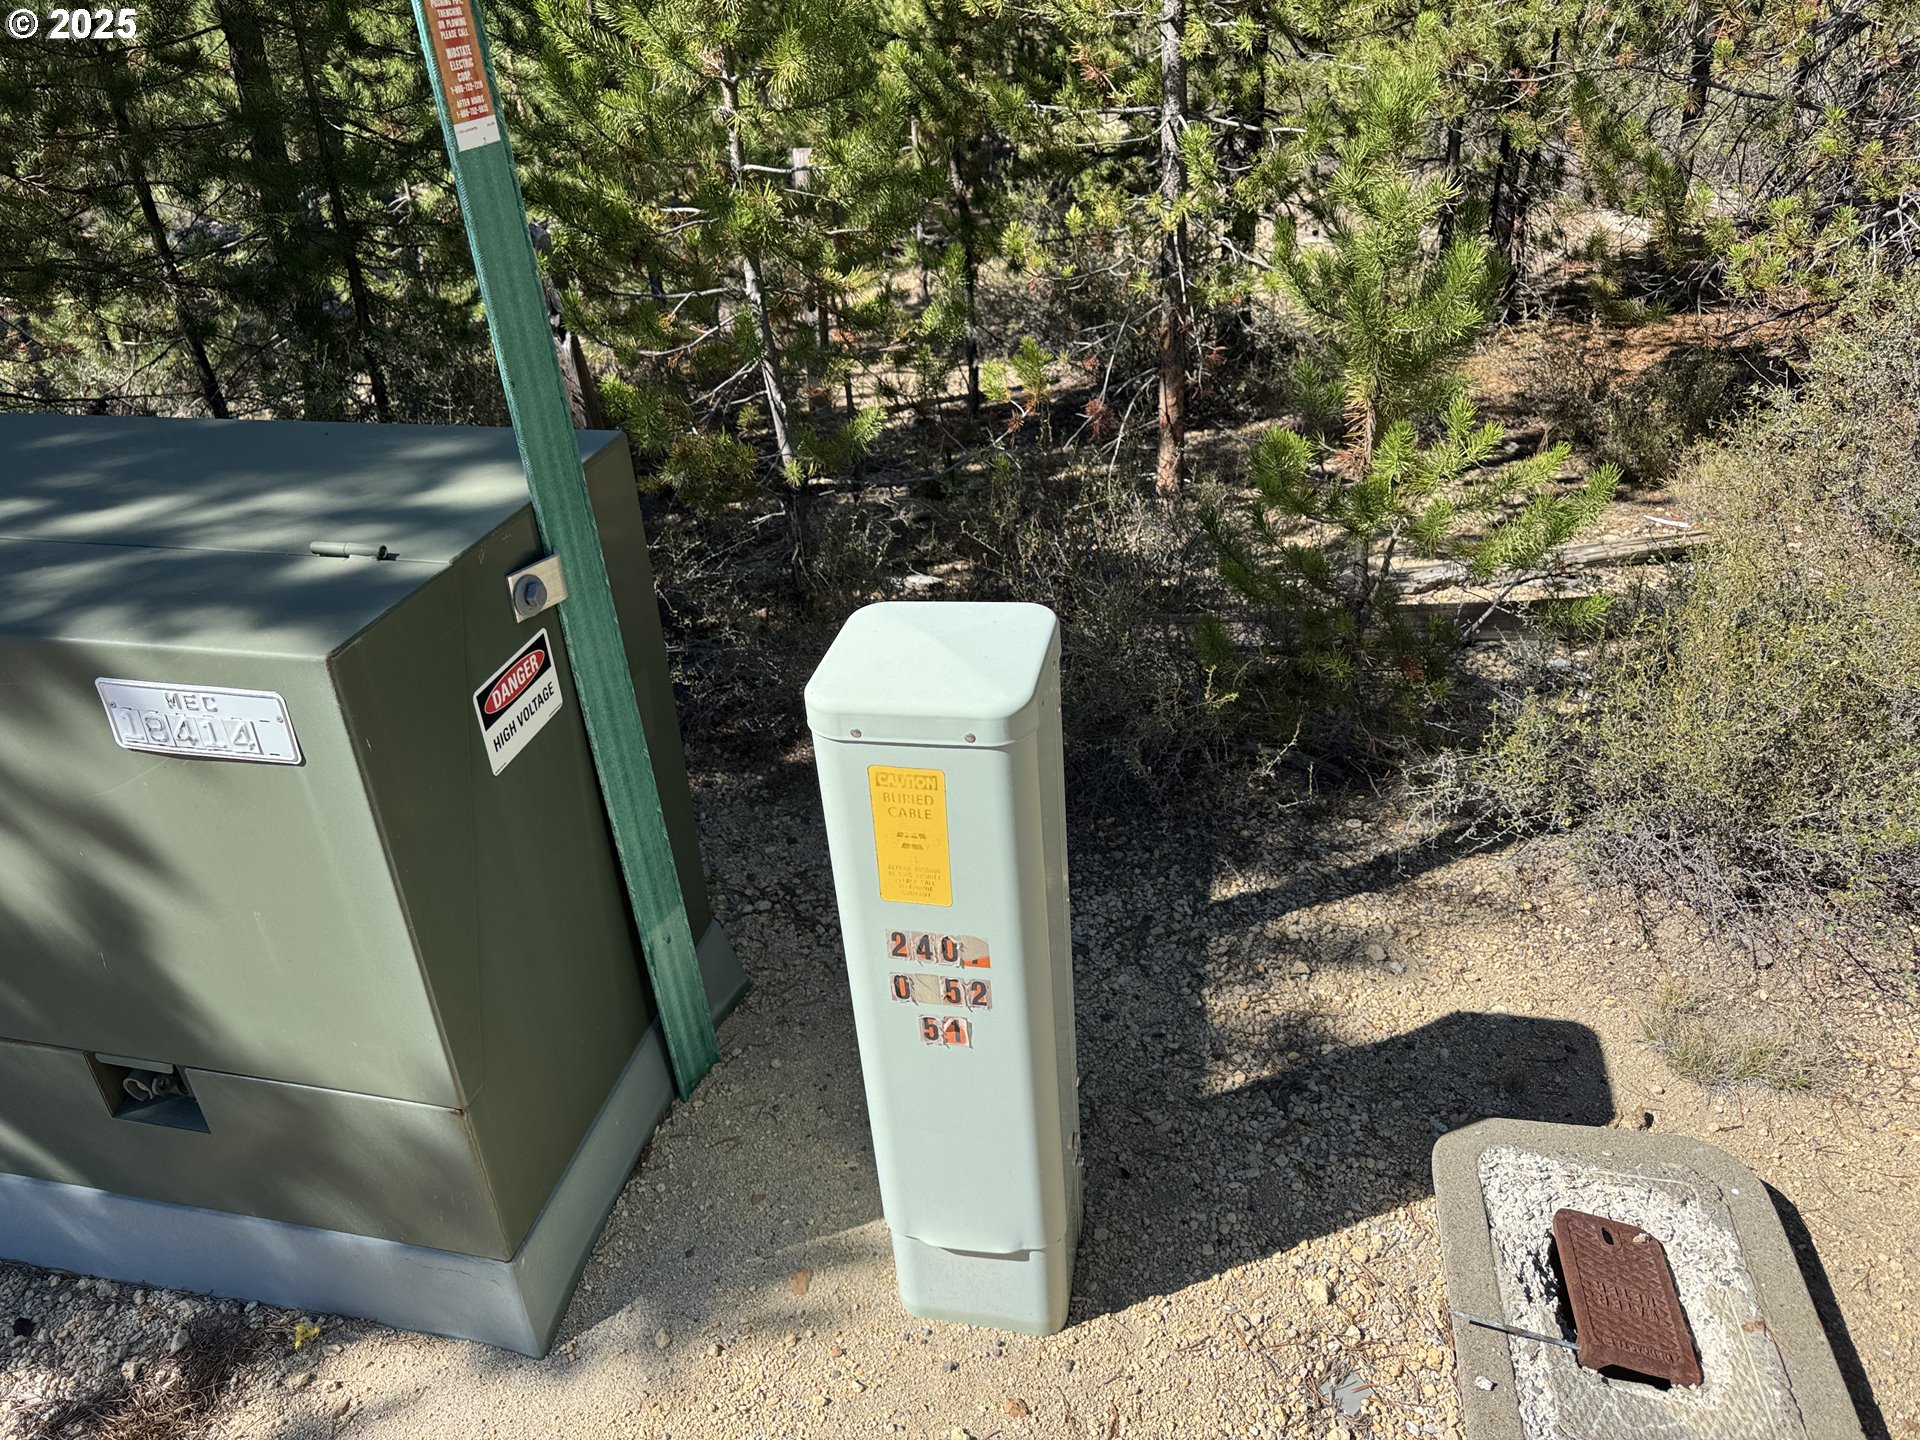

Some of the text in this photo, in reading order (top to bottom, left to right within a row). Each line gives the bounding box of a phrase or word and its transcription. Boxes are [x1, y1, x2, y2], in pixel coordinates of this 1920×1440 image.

[438, 20, 446, 29] OR
[440, 28, 469, 40] PLEASE CALL
[445, 45, 472, 59] MIDSTATE
[450, 58, 474, 71] ELECTRIC
[456, 95, 484, 108] AFTER HOURS
[491, 653, 539, 710] DANGER
[164, 692, 219, 713] MEC
[493, 720, 518, 753] HIGH
[516, 681, 555, 727] VOLTAGE
[118, 711, 256, 751] 18414
[877, 772, 938, 790] CAUTION
[883, 791, 934, 806] BURIED
[888, 806, 932, 820] CABLE
[891, 931, 979, 964] 240
[944, 978, 988, 1006] 52
